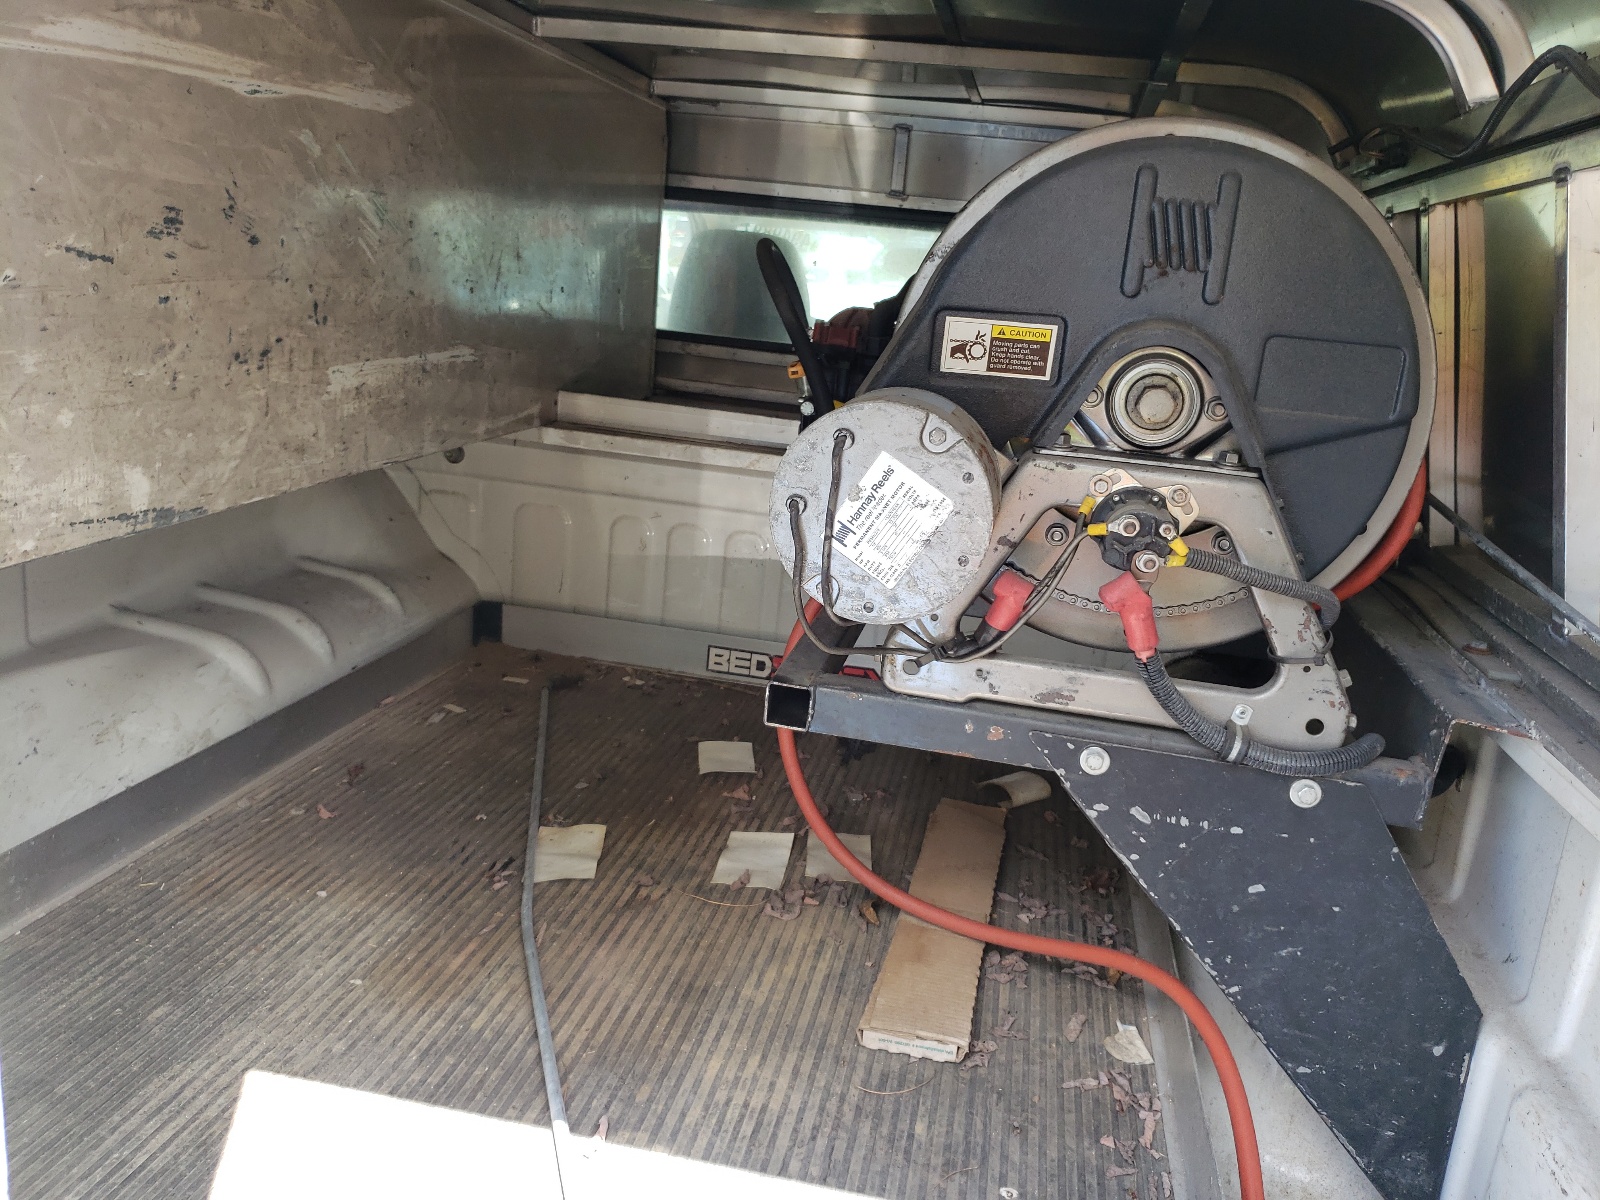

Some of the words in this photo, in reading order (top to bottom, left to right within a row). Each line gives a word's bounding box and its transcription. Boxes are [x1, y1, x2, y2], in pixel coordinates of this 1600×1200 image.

[992, 340, 1013, 348] Moving
[1009, 329, 1047, 339] CAUTION
[846, 490, 877, 527] Hannay
[870, 465, 894, 493] Reels
[852, 519, 876, 549] PERMANENT
[890, 481, 905, 500] MOTOR
[855, 519, 865, 531] The
[862, 508, 874, 521] reel
